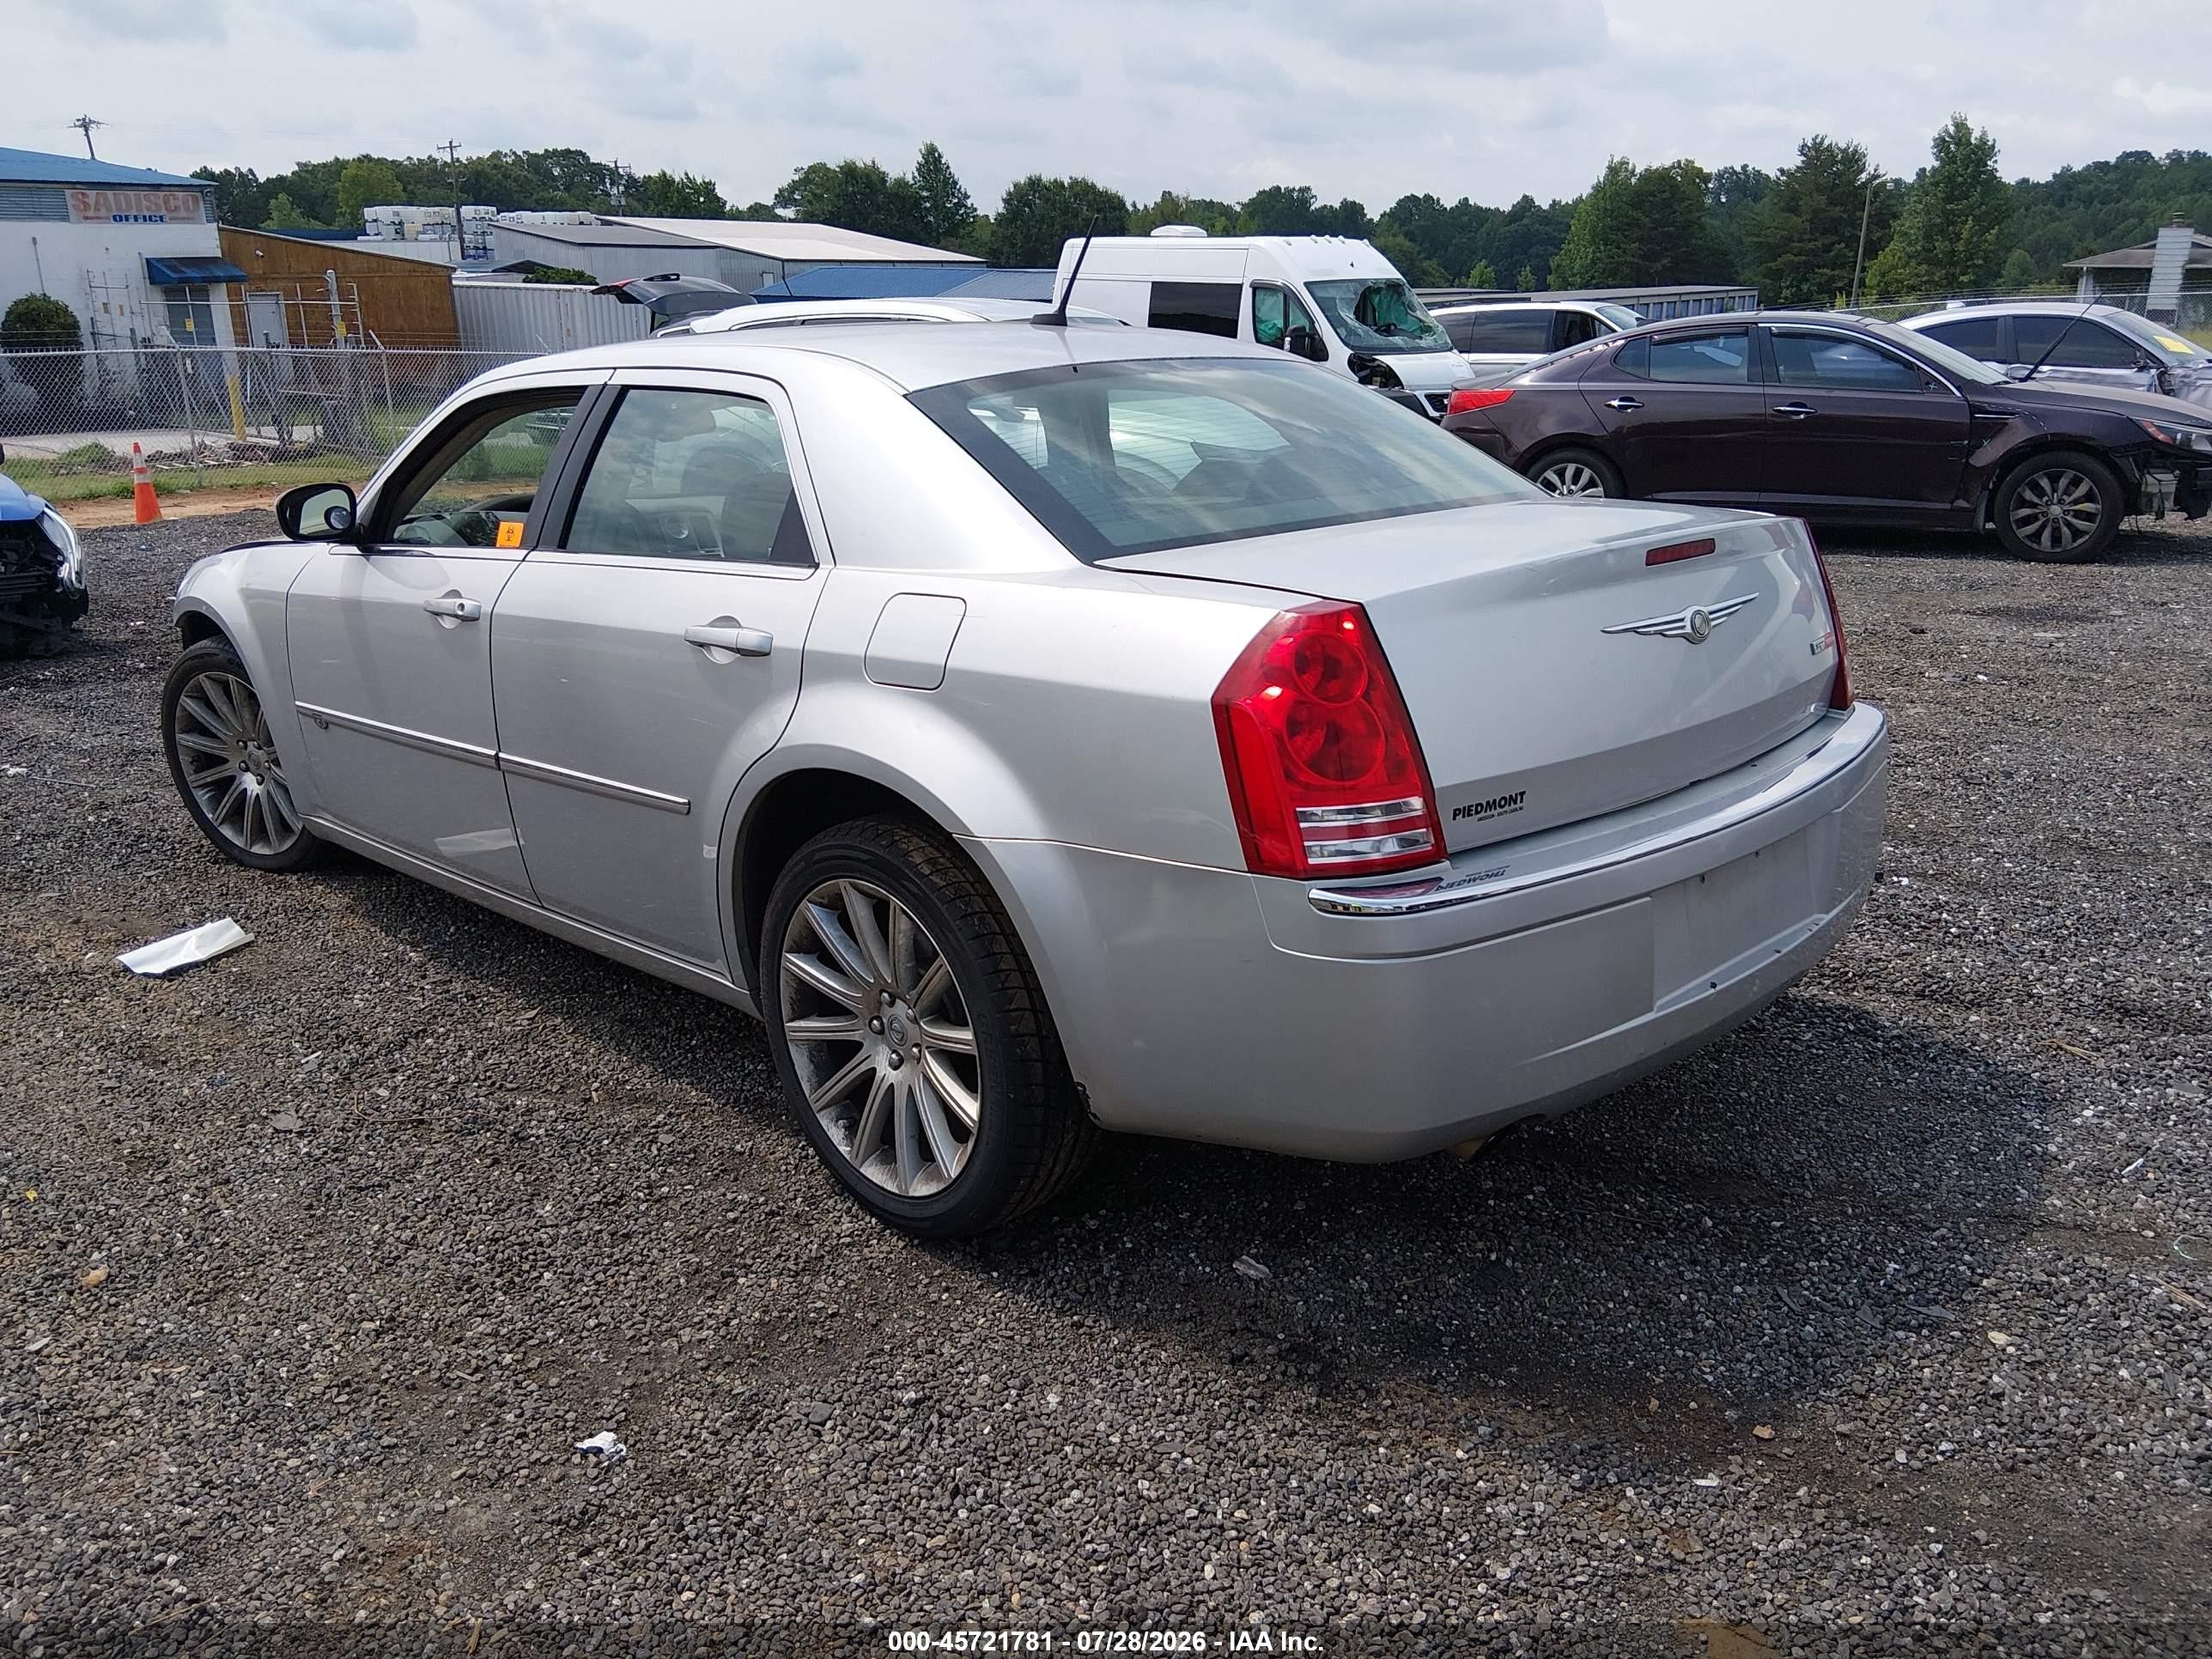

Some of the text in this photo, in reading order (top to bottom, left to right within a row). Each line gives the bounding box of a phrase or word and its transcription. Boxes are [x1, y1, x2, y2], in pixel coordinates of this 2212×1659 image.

[70, 191, 200, 214] SADISCO
[112, 214, 166, 223] OFFICE
[1452, 790, 1527, 821] PIEDMONT
